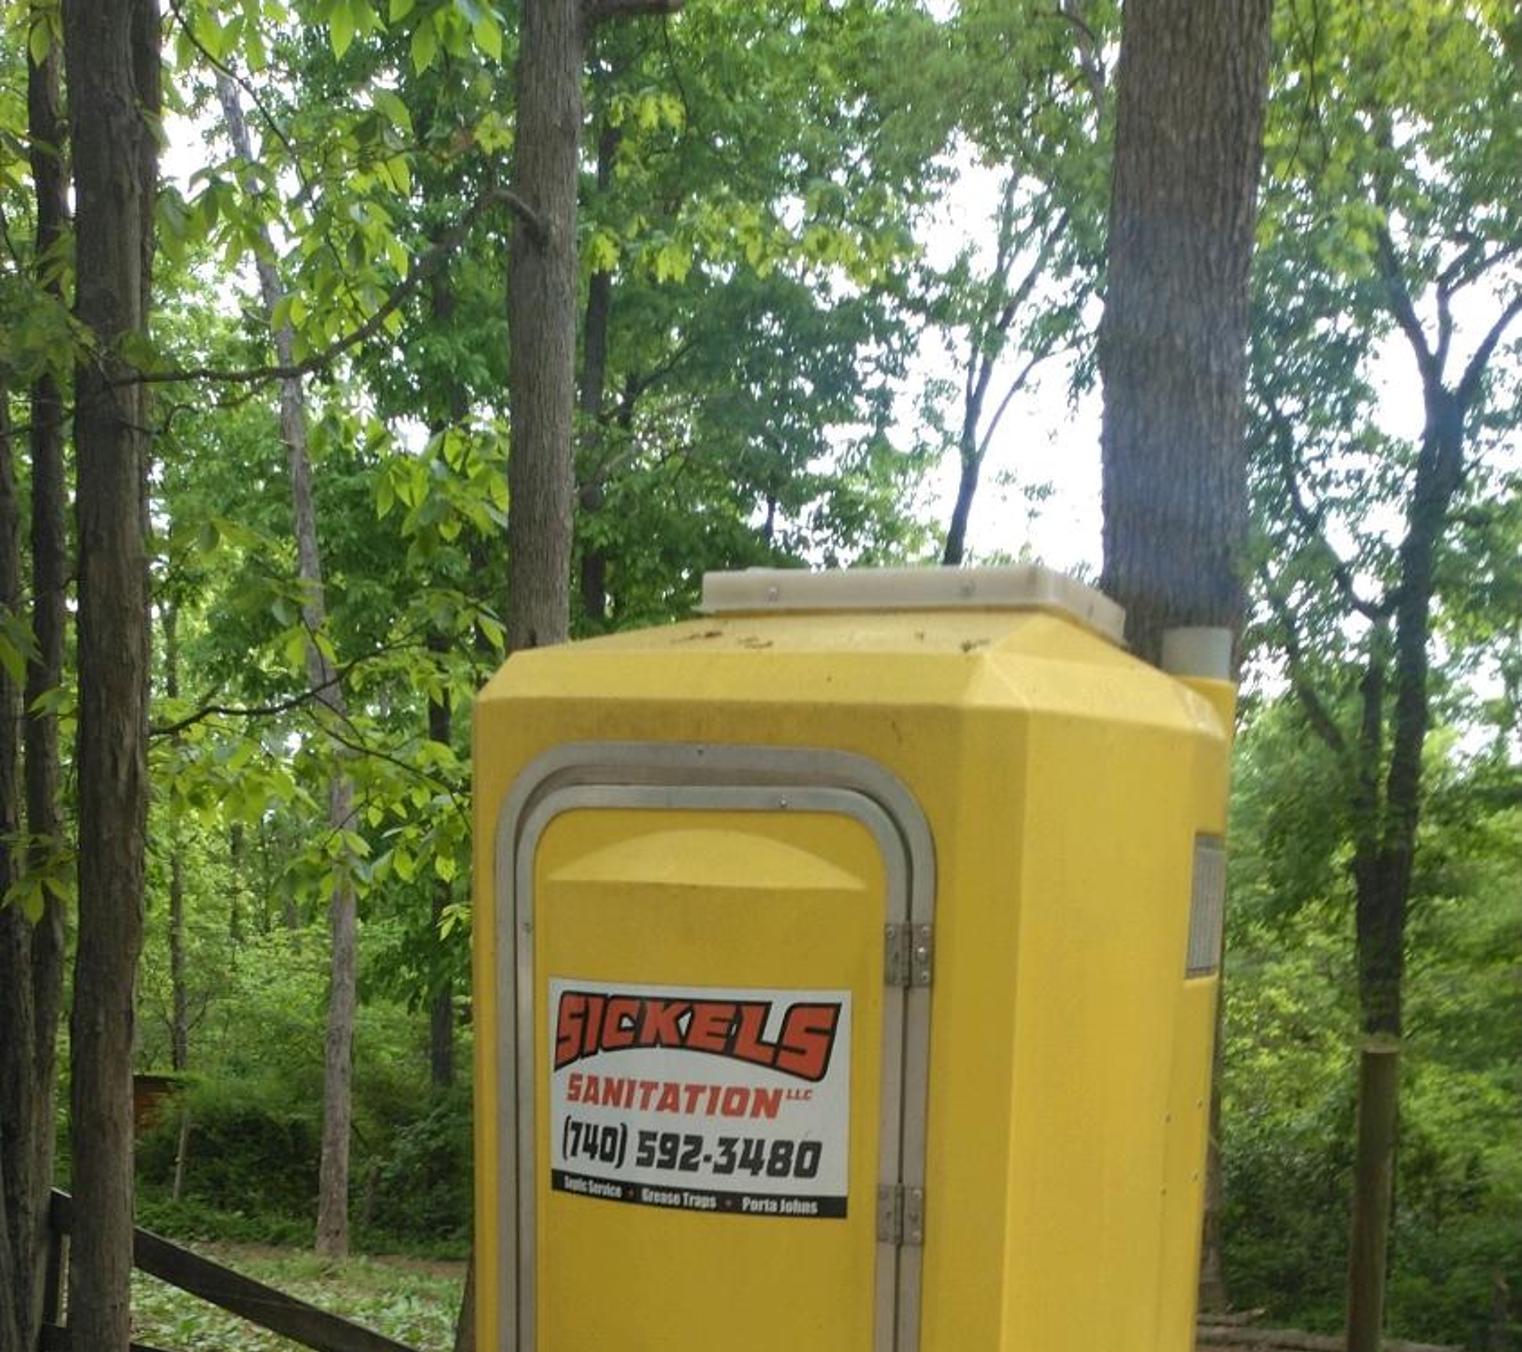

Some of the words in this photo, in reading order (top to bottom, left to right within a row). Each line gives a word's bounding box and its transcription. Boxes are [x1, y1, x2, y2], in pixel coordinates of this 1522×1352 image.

[554, 990, 842, 1083] SICKELS
[567, 1073, 784, 1120] SANITATION
[786, 1088, 813, 1101] LLC
[562, 1114, 629, 1170] (740)
[588, 1180, 622, 1198] Service
[642, 1187, 681, 1206] Grease
[683, 1192, 717, 1209] Traps
[742, 1196, 778, 1213] Porta
[779, 1198, 818, 1214] Johns
